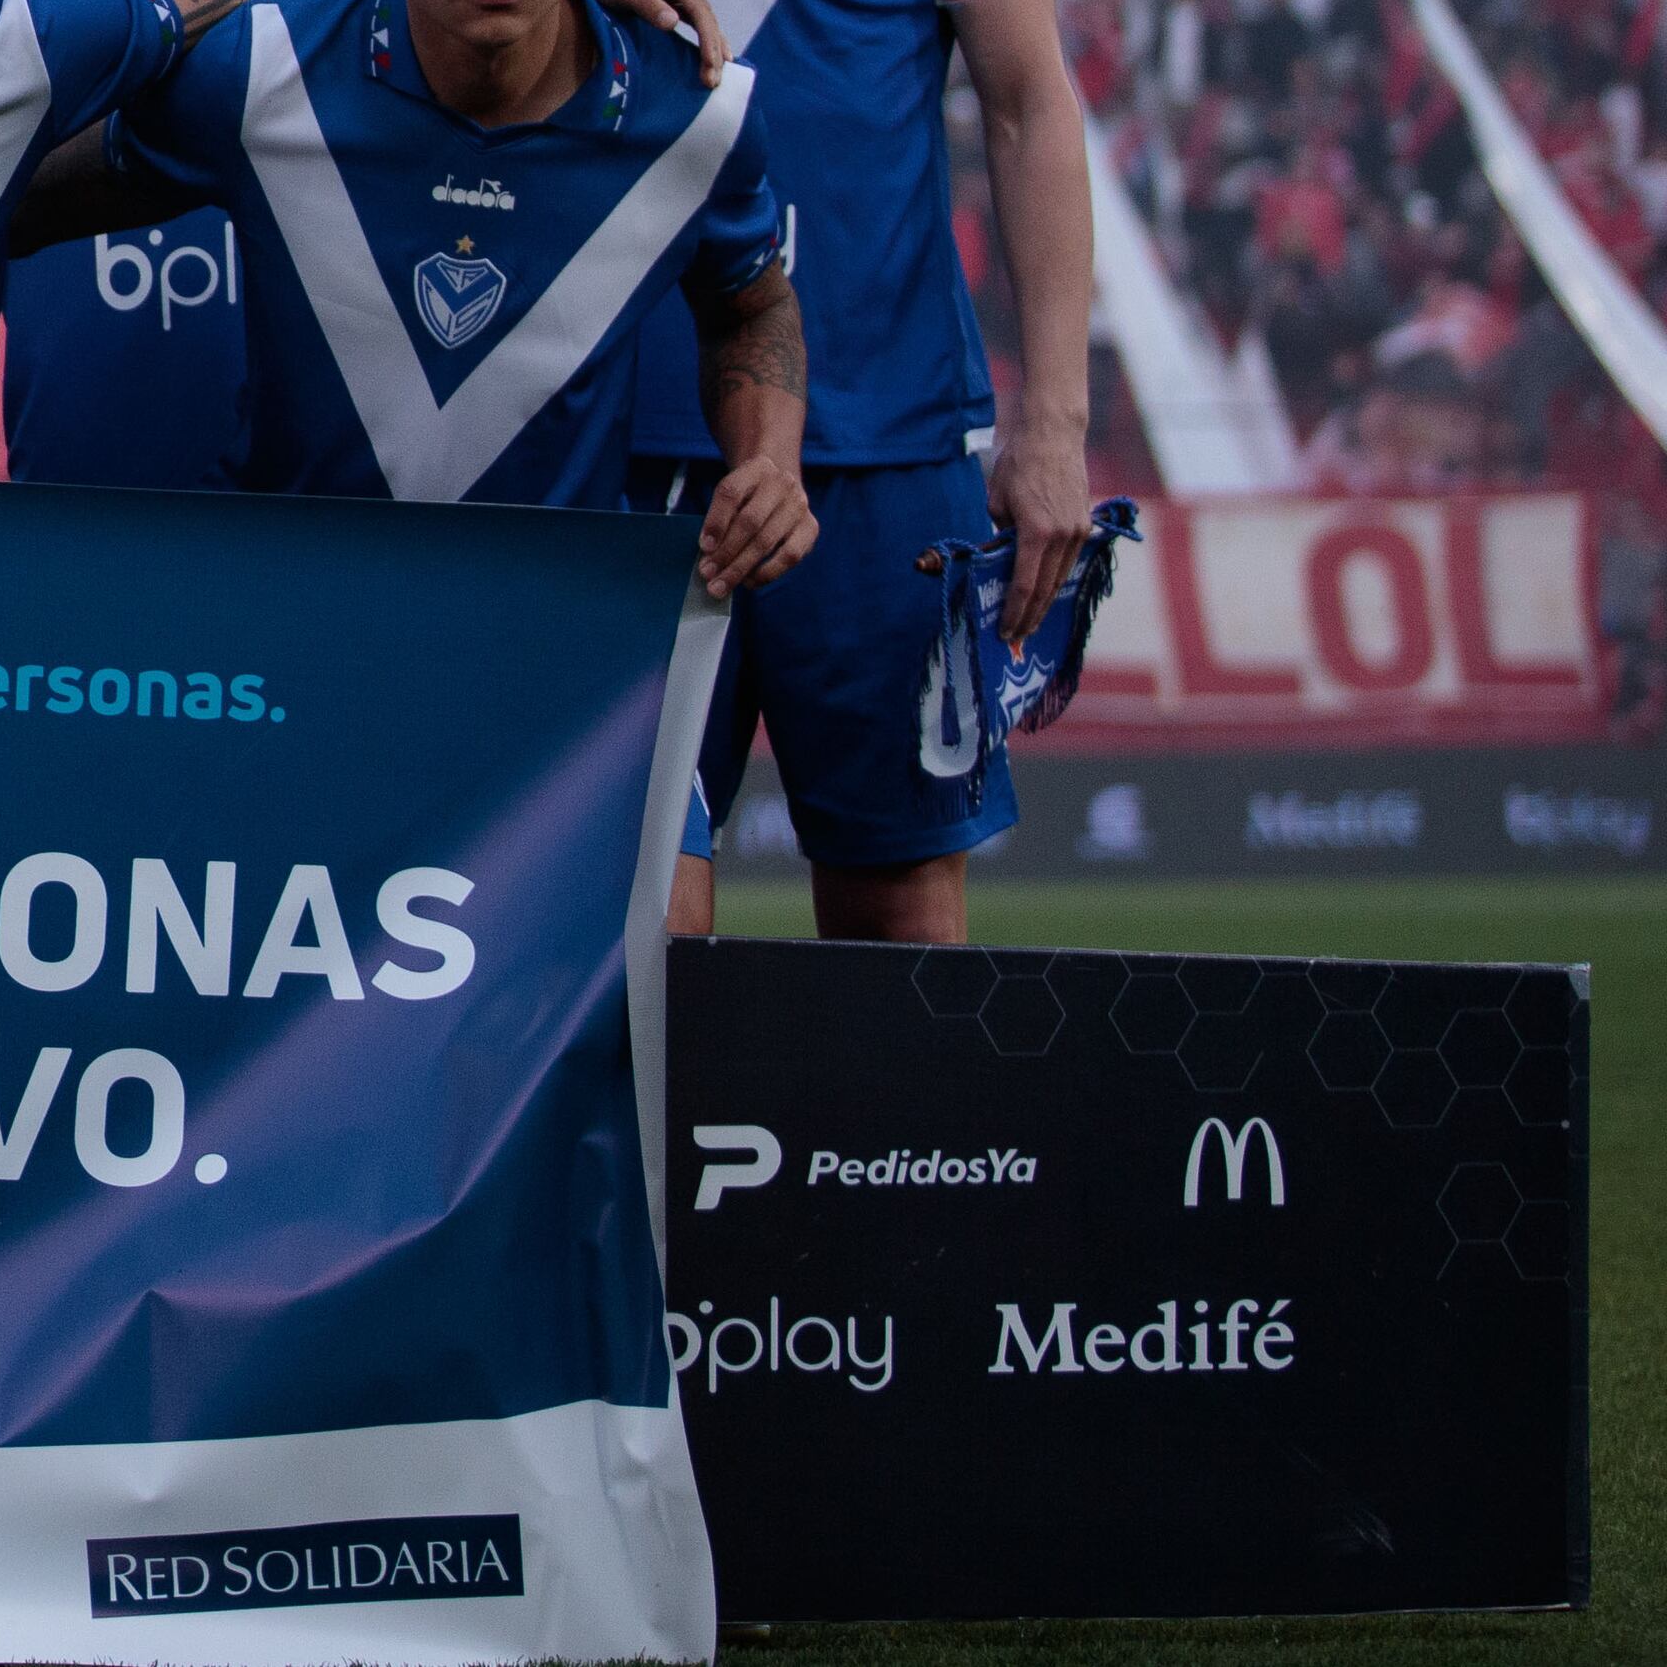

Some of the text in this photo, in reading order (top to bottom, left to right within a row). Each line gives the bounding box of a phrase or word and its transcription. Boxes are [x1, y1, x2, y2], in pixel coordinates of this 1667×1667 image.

[432, 173, 516, 211] diadora
[94, 220, 237, 331] bpl
[1075, 502, 1585, 696] LOL
[807, 1147, 1037, 1186] PedidosYa
[987, 1298, 1295, 1373] Medifé
[107, 1539, 509, 1602] RED SOLIDARIA
